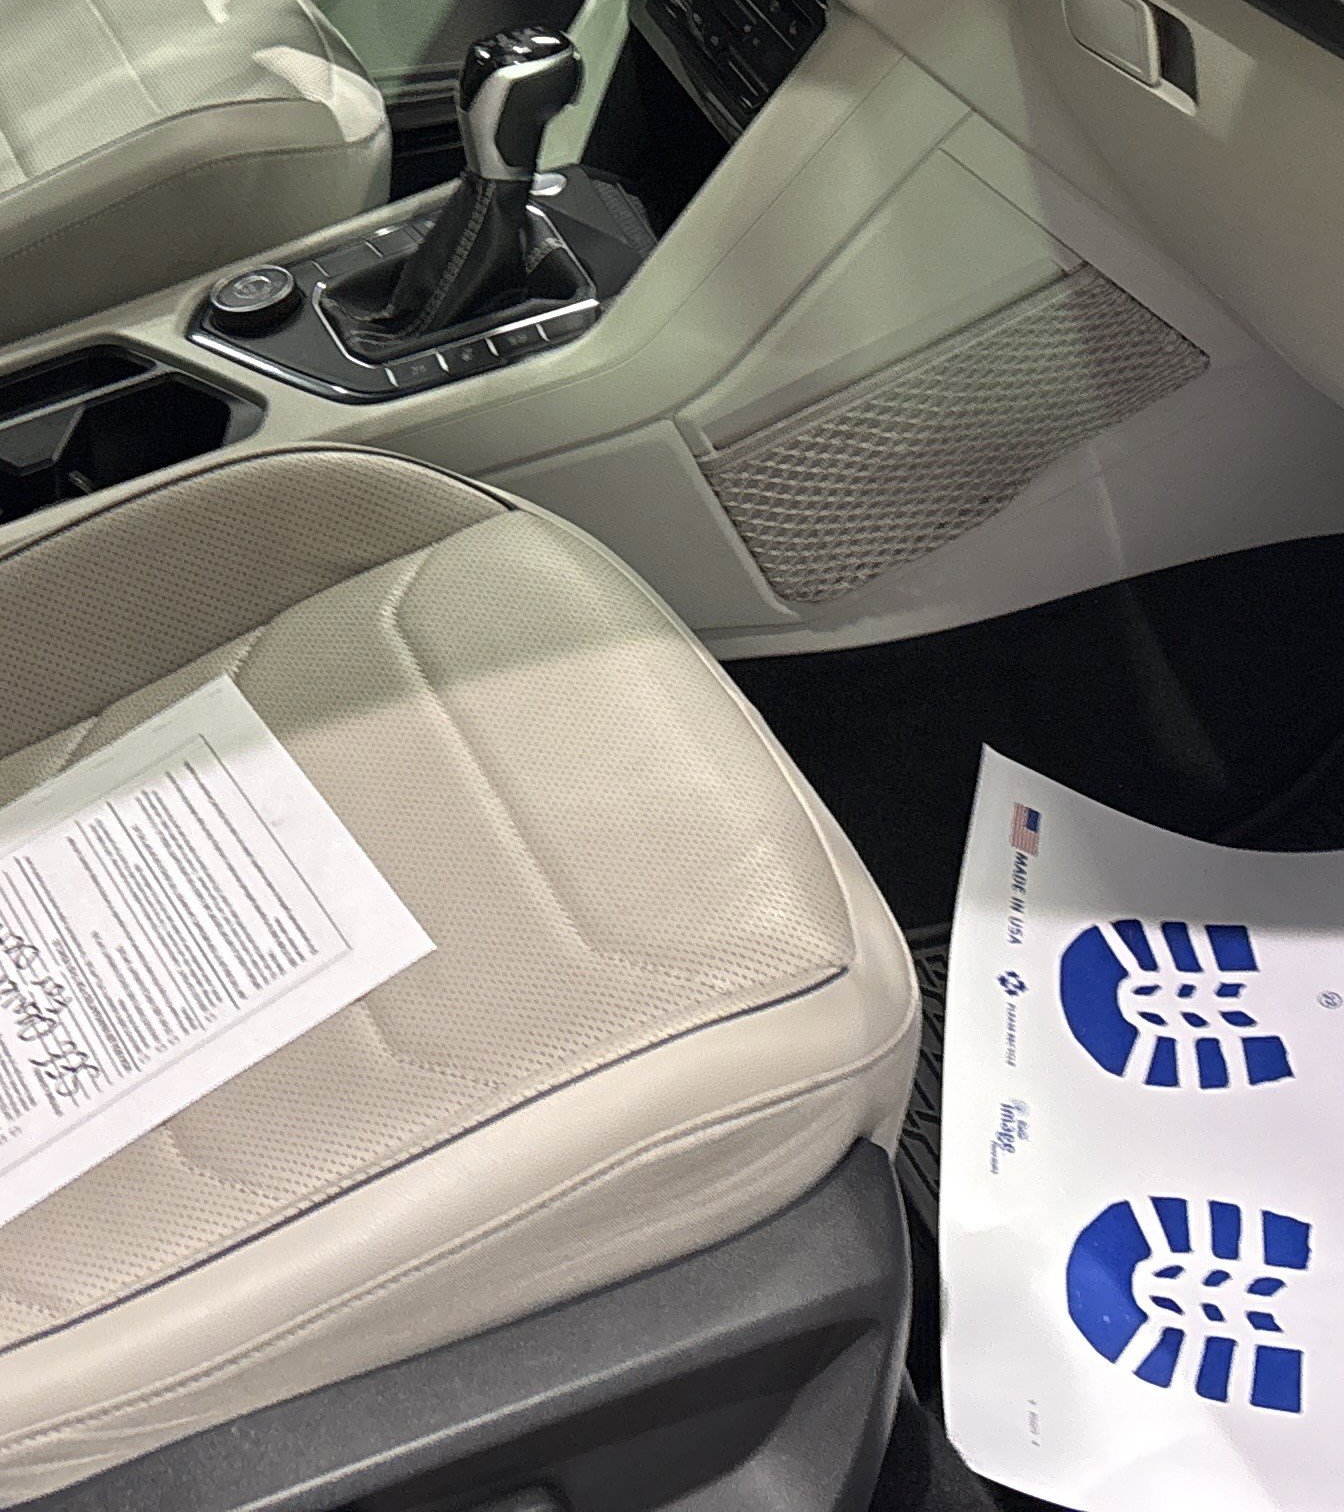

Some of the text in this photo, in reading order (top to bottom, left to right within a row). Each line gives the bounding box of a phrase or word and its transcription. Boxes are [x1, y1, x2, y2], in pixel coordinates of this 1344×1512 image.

[1007, 851, 1029, 945] MADE IN USA
